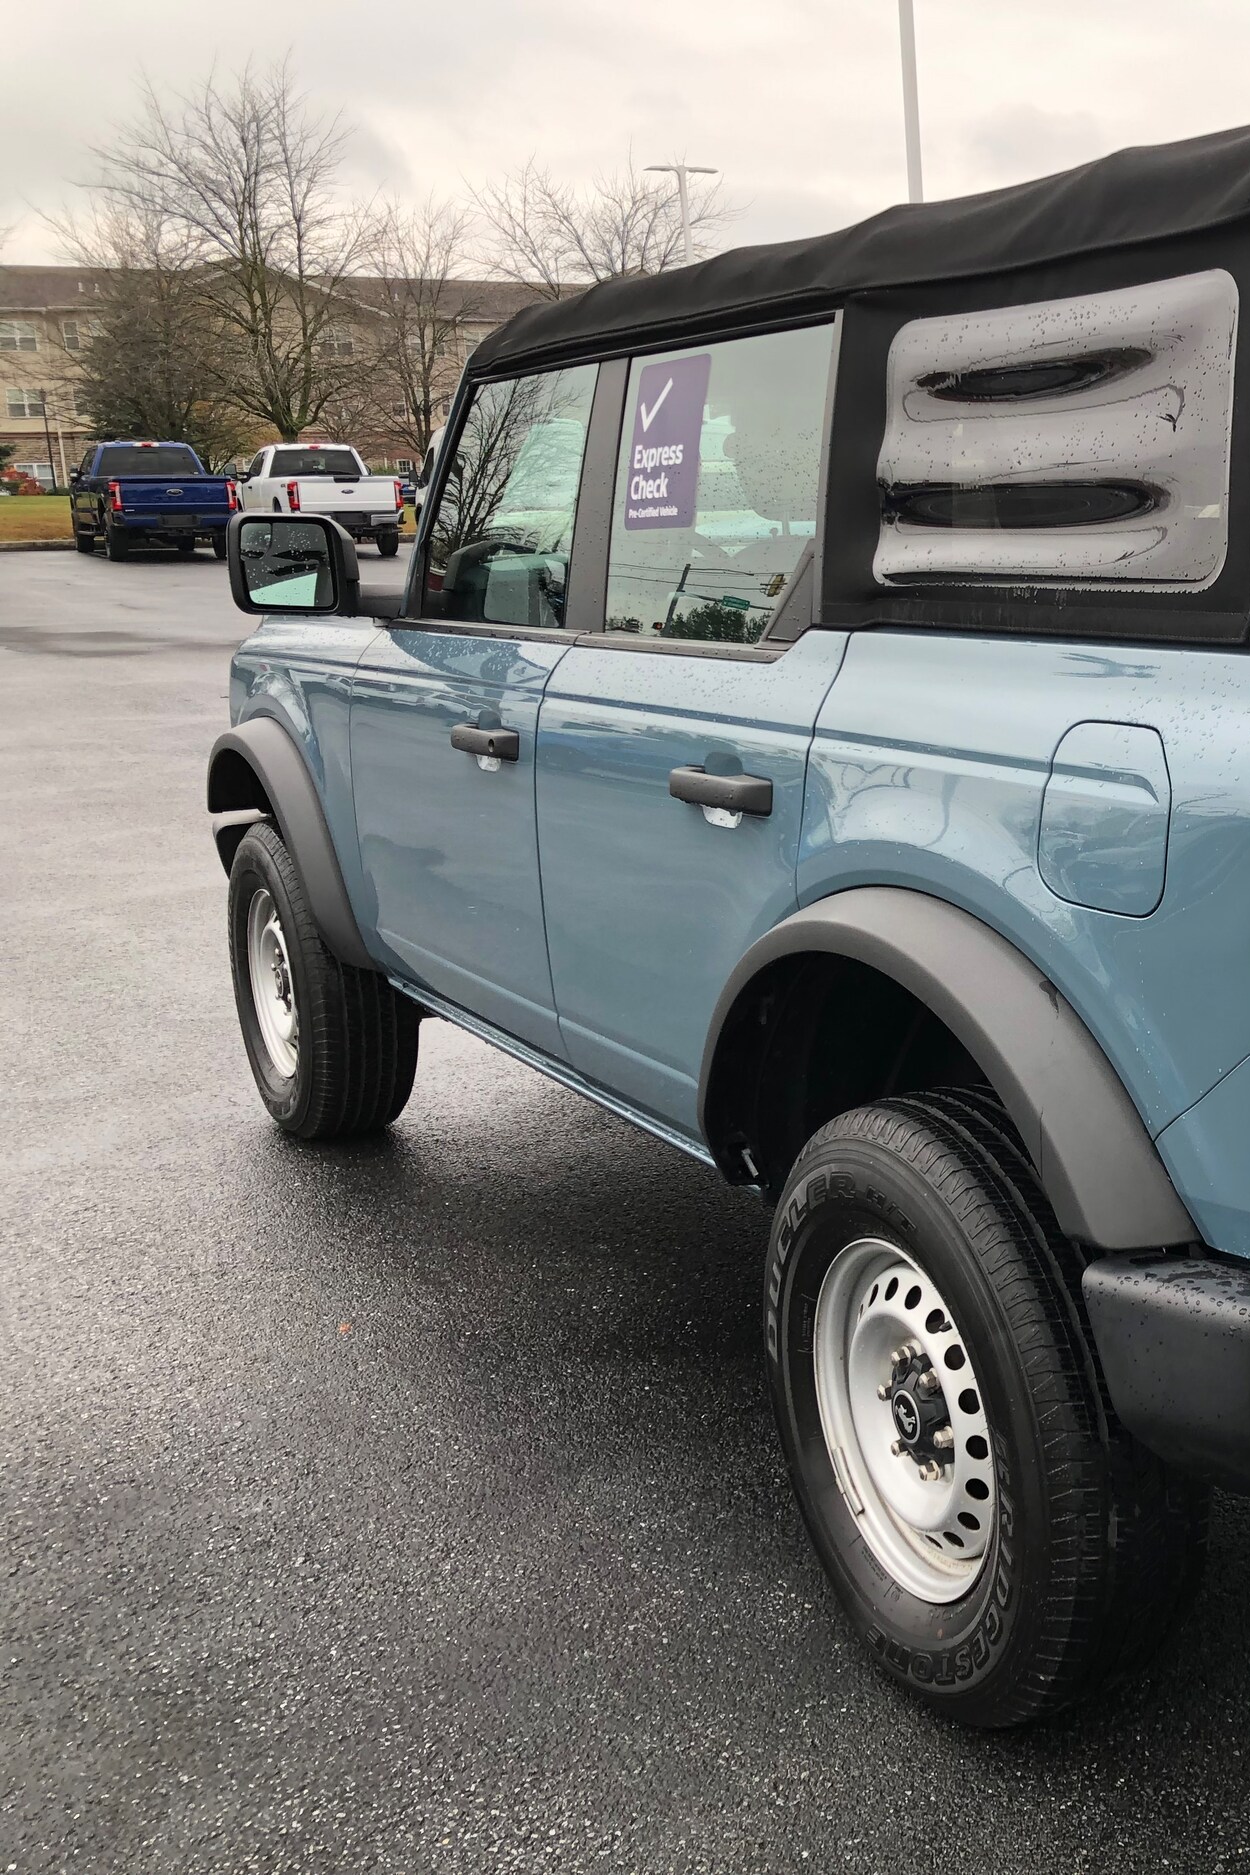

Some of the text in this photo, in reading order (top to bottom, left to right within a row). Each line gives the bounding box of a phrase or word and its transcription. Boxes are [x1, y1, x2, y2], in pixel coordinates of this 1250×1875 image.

[634, 444, 684, 473] Express
[630, 472, 669, 500] Check
[628, 505, 678, 519] Pre-Certified Vehicle
[767, 1171, 856, 1364] DUELER
[865, 1425, 1014, 1686] BRIDGESTONE
